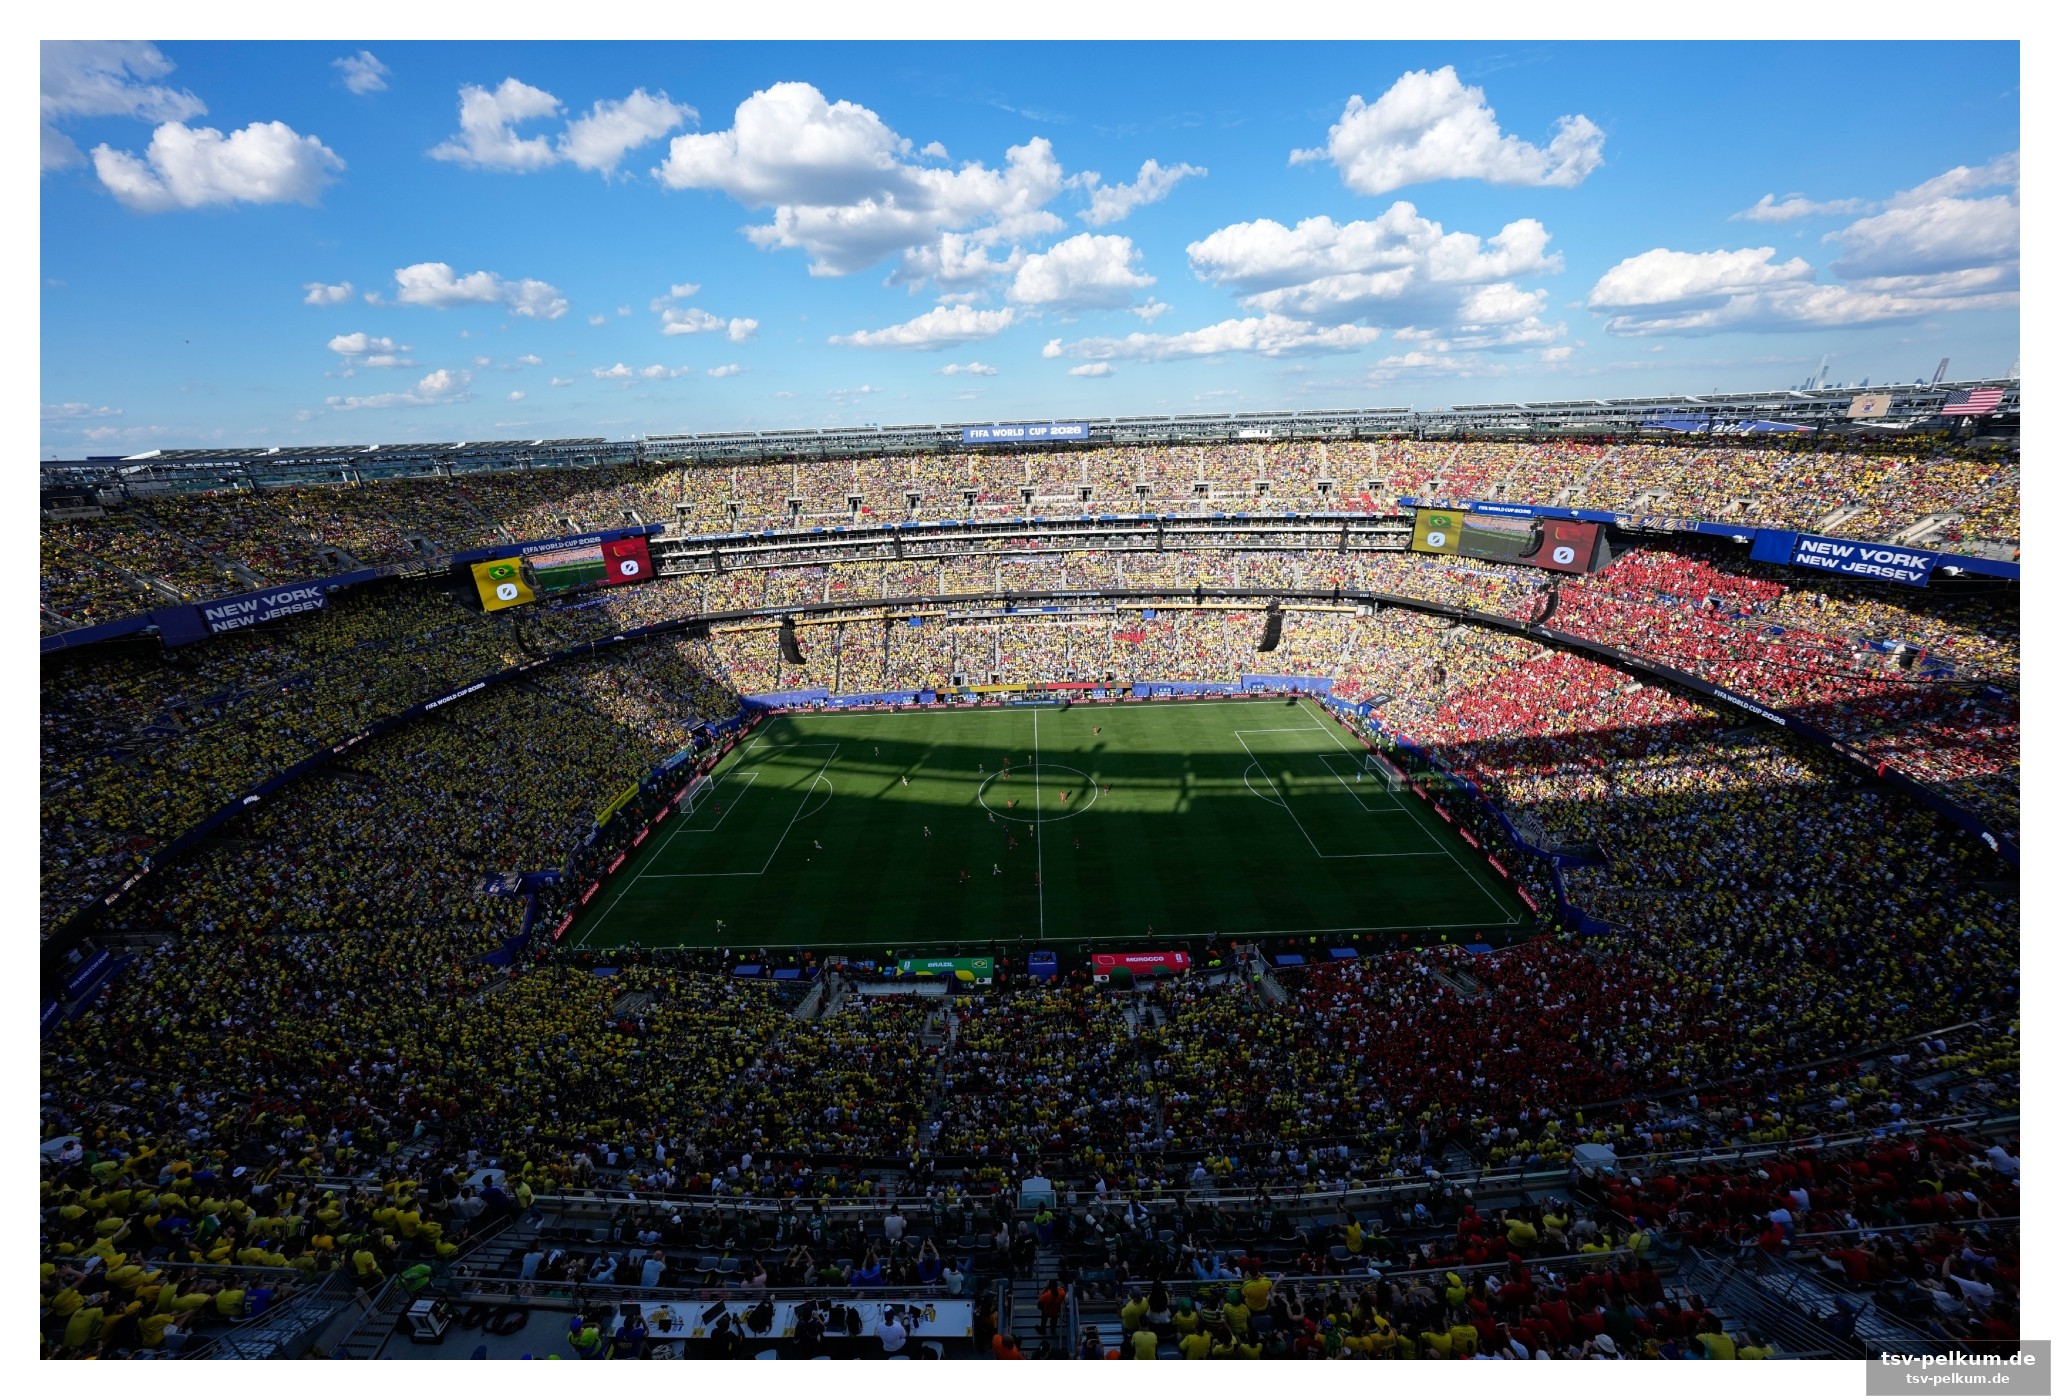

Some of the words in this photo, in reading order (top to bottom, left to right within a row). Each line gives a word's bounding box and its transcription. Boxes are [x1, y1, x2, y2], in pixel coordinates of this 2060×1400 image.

[970, 429, 989, 438] FIFA
[992, 428, 1024, 437] WORLD
[1029, 427, 1048, 436] CUP
[1050, 426, 1082, 435] 2026
[522, 546, 539, 554] FIFA
[538, 542, 565, 552] WORLD
[564, 540, 579, 549] CUP
[579, 536, 602, 545] 2026
[1800, 540, 1855, 558] NEW
[1860, 548, 1930, 570] YORK
[1796, 553, 1840, 568] NEW
[1842, 562, 1923, 581] JERSEY
[205, 600, 258, 620] NEW
[261, 586, 322, 607] YORK
[211, 614, 254, 633] NEW
[258, 598, 324, 621] JERSEY
[1713, 689, 1727, 700] FIFA
[1727, 694, 1749, 709] WORLD
[1748, 705, 1762, 715] CUP
[1761, 711, 1786, 726] 2026
[1434, 803, 1451, 823] Lenovo
[1460, 827, 1478, 848] Lenovo
[1488, 855, 1508, 878] Lenovo
[581, 883, 599, 905] Lenovo
[1518, 886, 1537, 912] Lenovo
[554, 914, 573, 940] Lenovo
